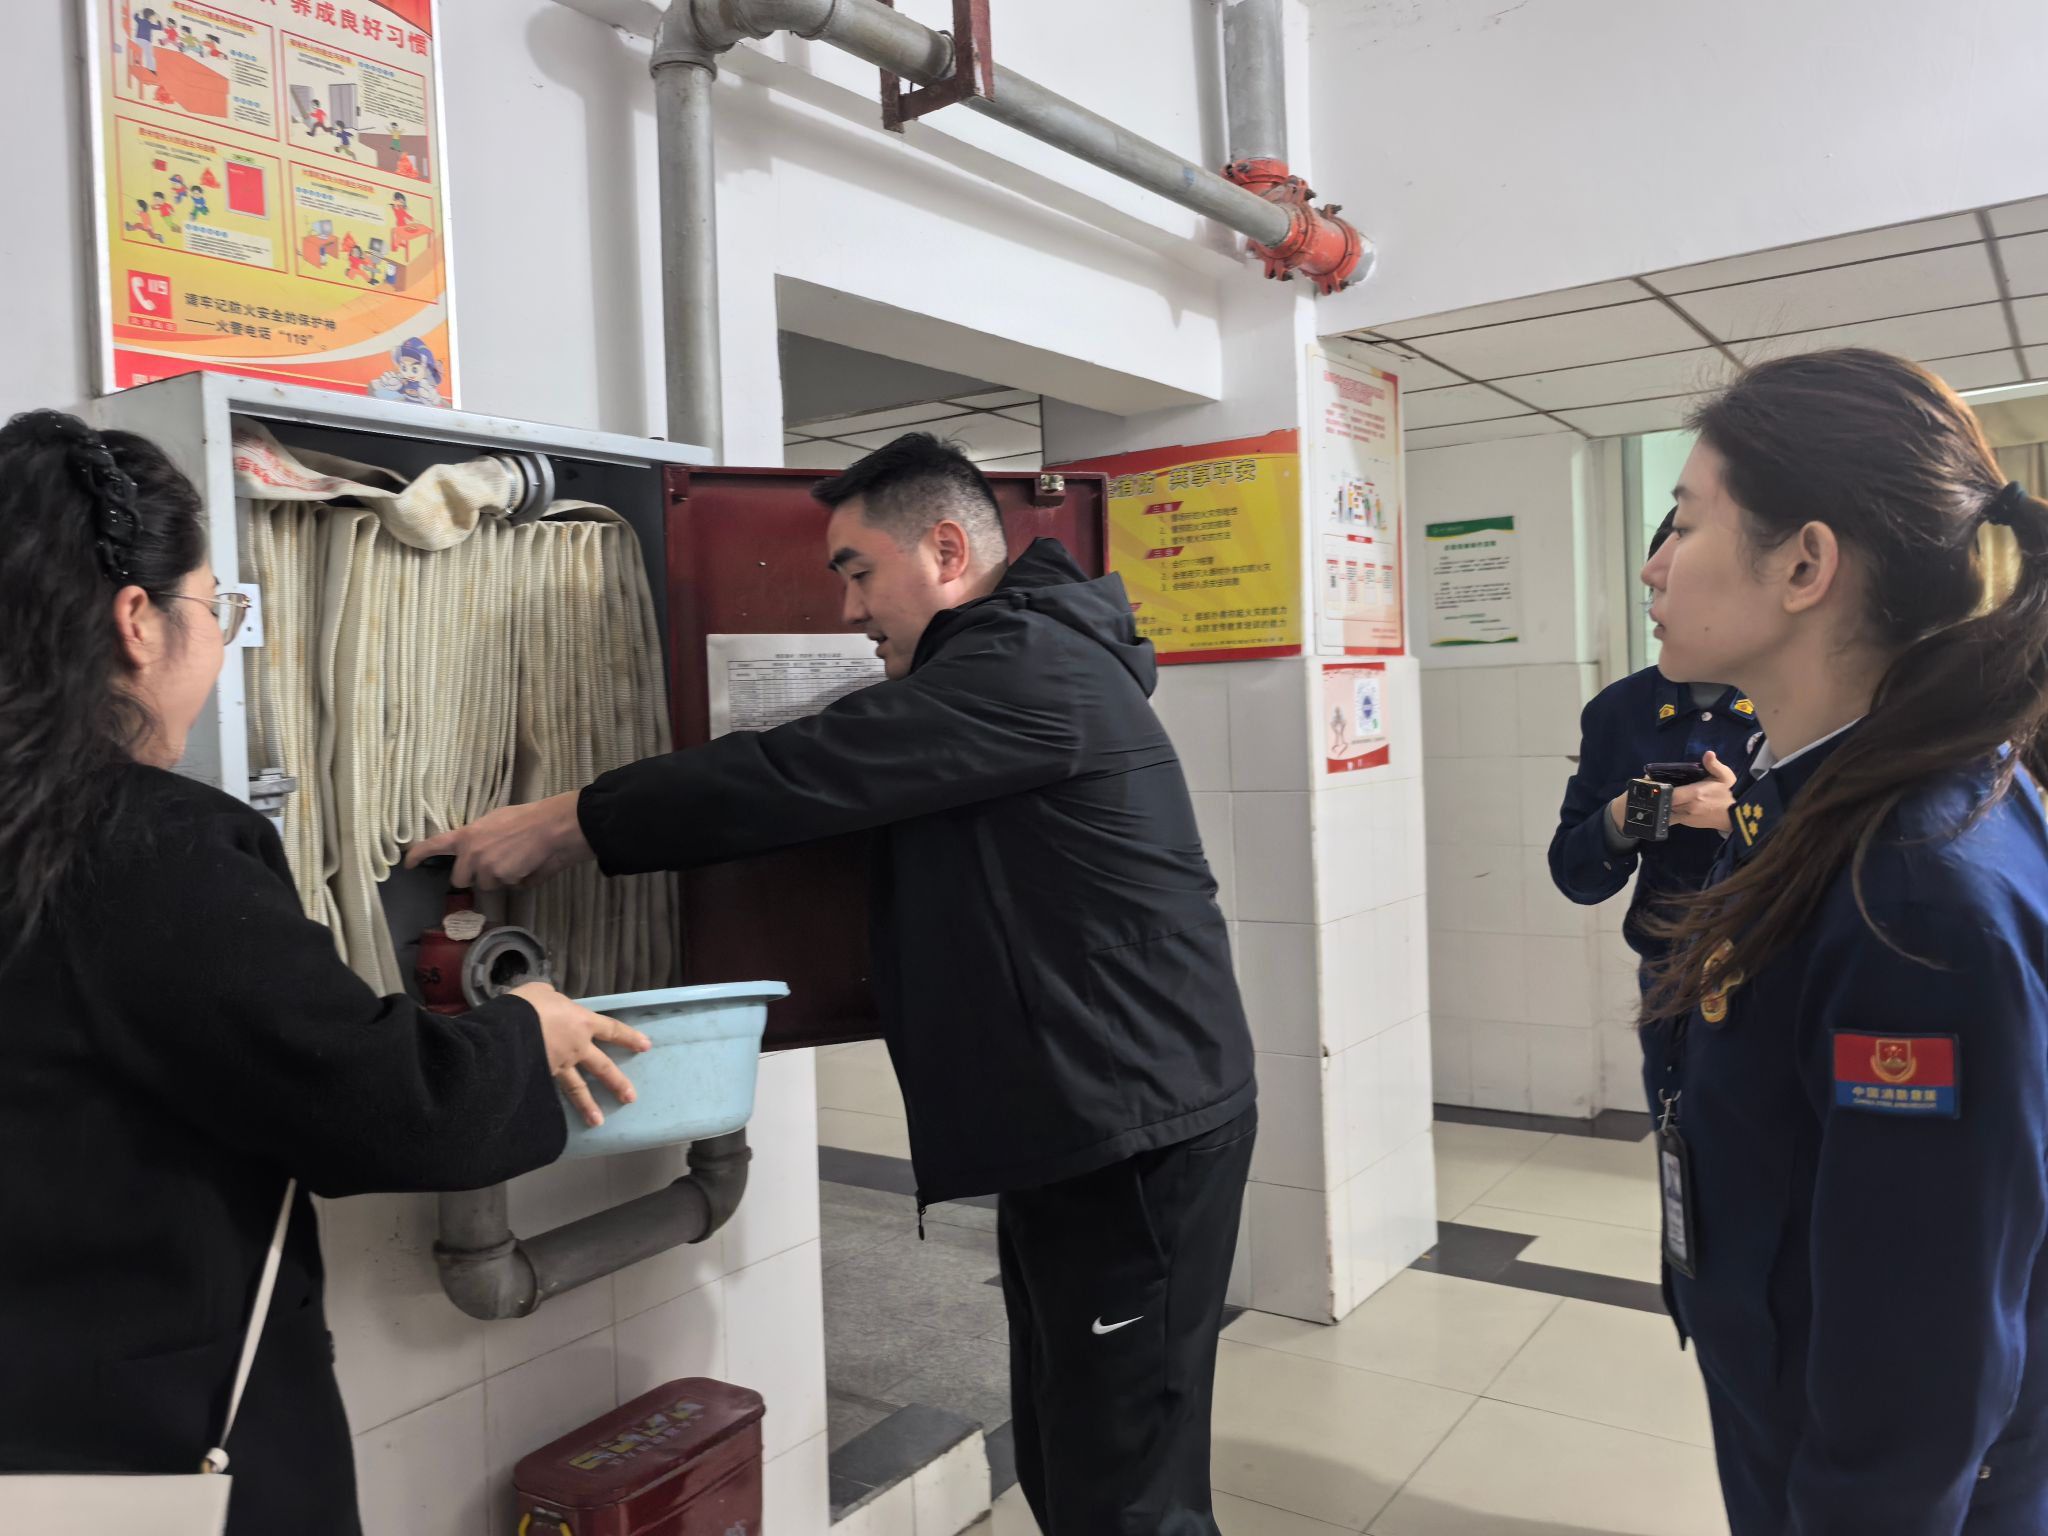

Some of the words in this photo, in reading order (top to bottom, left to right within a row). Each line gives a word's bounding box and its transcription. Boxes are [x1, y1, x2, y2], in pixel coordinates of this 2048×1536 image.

[291, 0, 429, 57] 养成良好习惯
[184, 292, 337, 331] 请牢记防火安全的保护神
[1168, 458, 1257, 491] 共享平安
